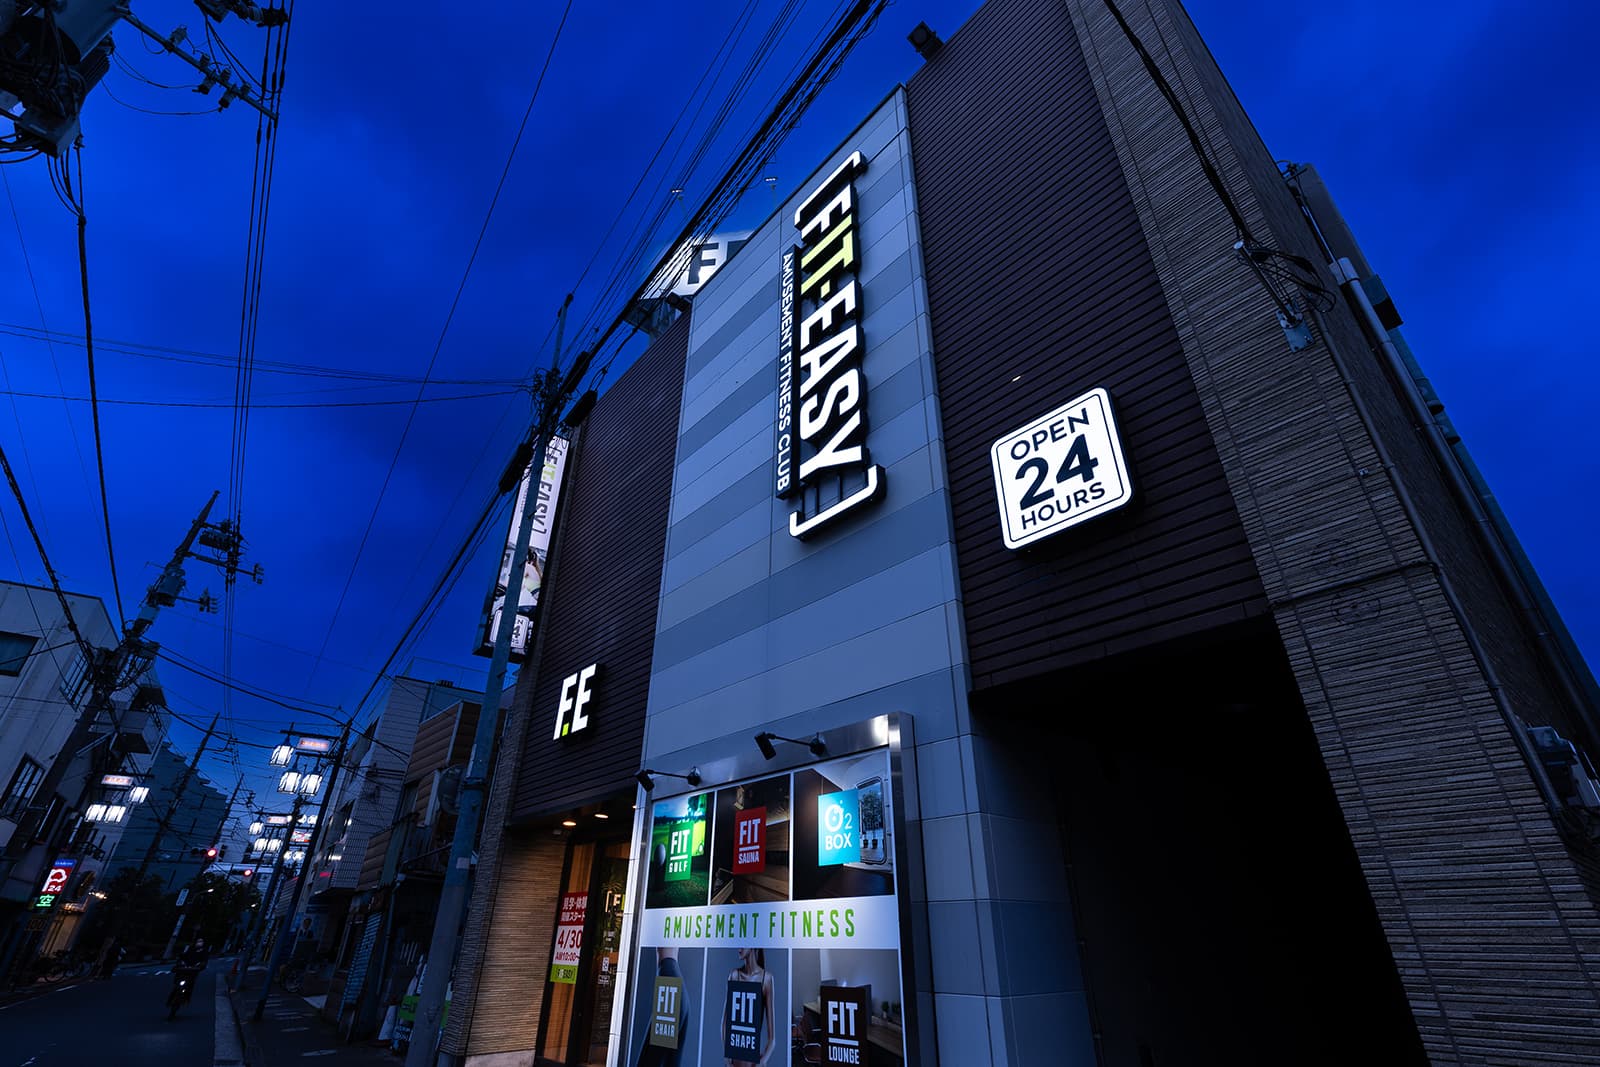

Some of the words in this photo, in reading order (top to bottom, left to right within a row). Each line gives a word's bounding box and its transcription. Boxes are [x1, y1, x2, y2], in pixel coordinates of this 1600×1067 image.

[780, 252, 794, 350] AMUSEMENT
[778, 351, 793, 431] FITNESS
[1010, 407, 1090, 461] OPEN
[777, 434, 791, 492] CLUB
[1015, 433, 1099, 511] 24
[1021, 481, 1106, 530] HOURS
[670, 829, 691, 855] FIT
[739, 818, 761, 846] FIT
[825, 832, 853, 851] BOX
[668, 860, 689, 874] GOLF
[738, 851, 760, 865] SAUNA
[664, 912, 760, 939] AMUSEMENT
[769, 908, 855, 938] FITNESS
[557, 929, 583, 950] 4/30
[656, 985, 678, 1015] FIT
[731, 991, 757, 1024] FIT
[655, 1023, 675, 1038] CHAIR
[828, 1000, 858, 1036] FIT
[730, 1033, 756, 1050] SHAPE
[828, 1045, 860, 1065] LOUNGE
